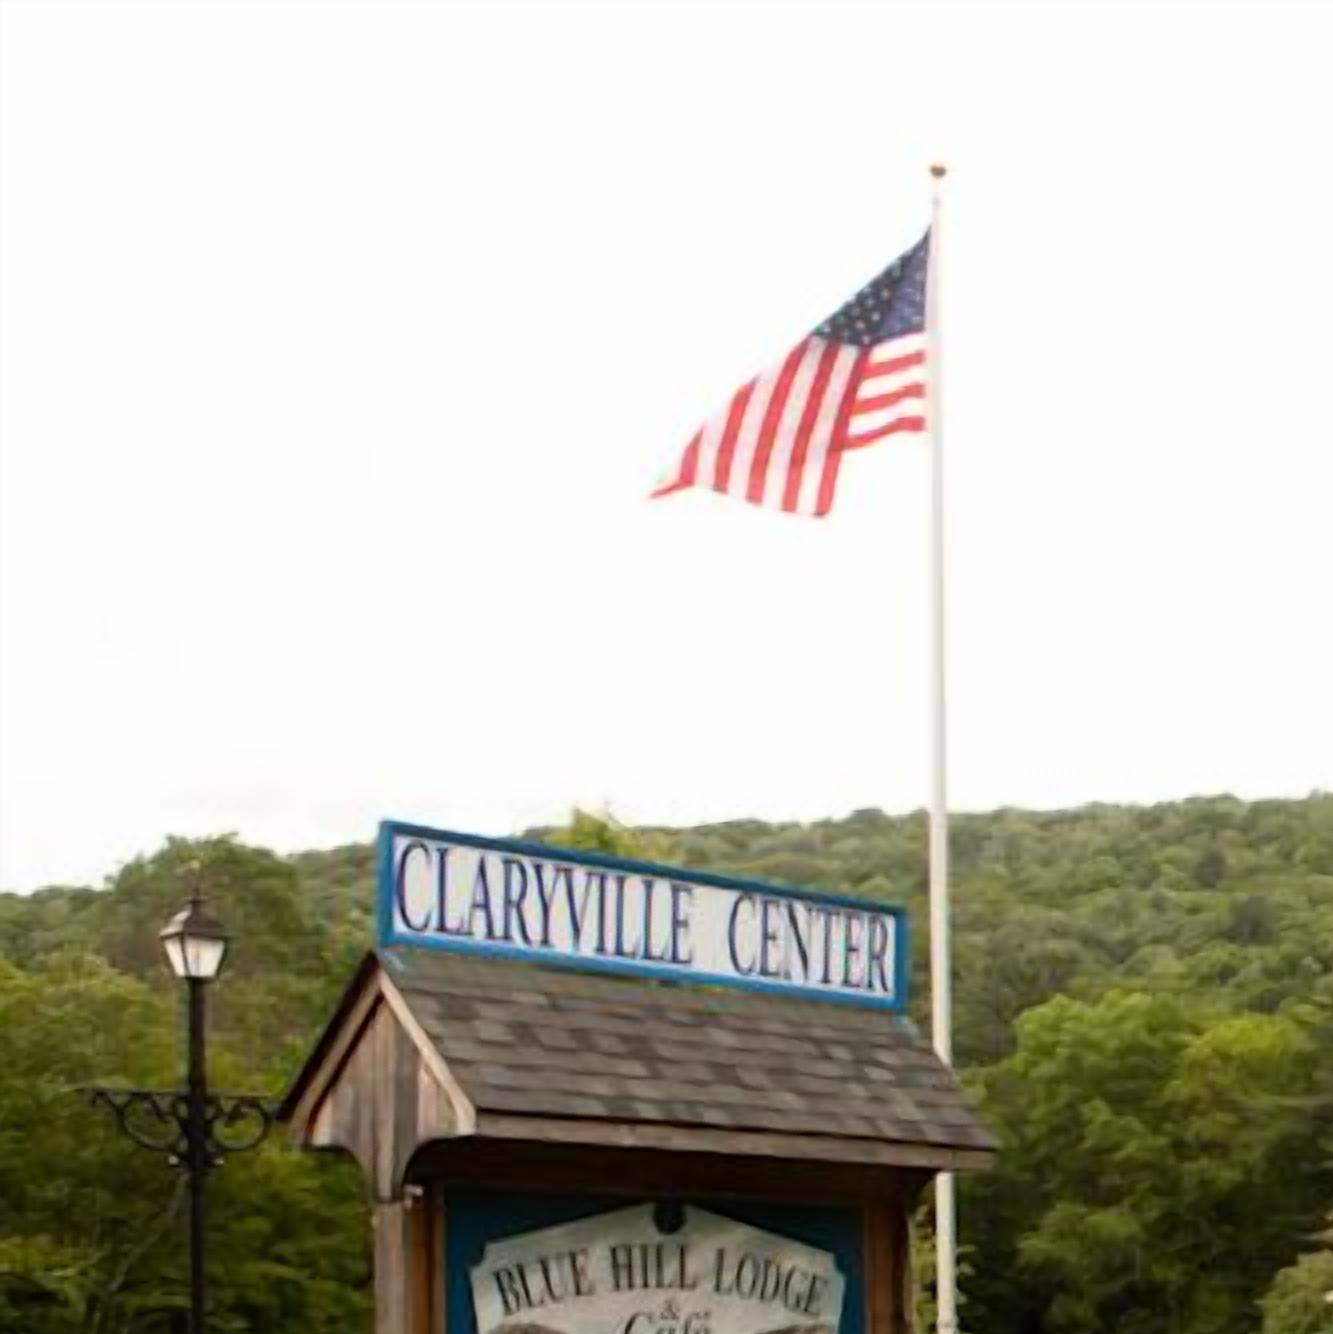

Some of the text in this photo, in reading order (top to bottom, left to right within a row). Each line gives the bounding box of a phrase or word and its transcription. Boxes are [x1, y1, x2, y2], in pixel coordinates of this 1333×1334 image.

[398, 841, 890, 993] CLARYVILLE CENTER
[493, 1243, 829, 1316] BLUE HILL LODGE
[658, 1300, 680, 1321] &
